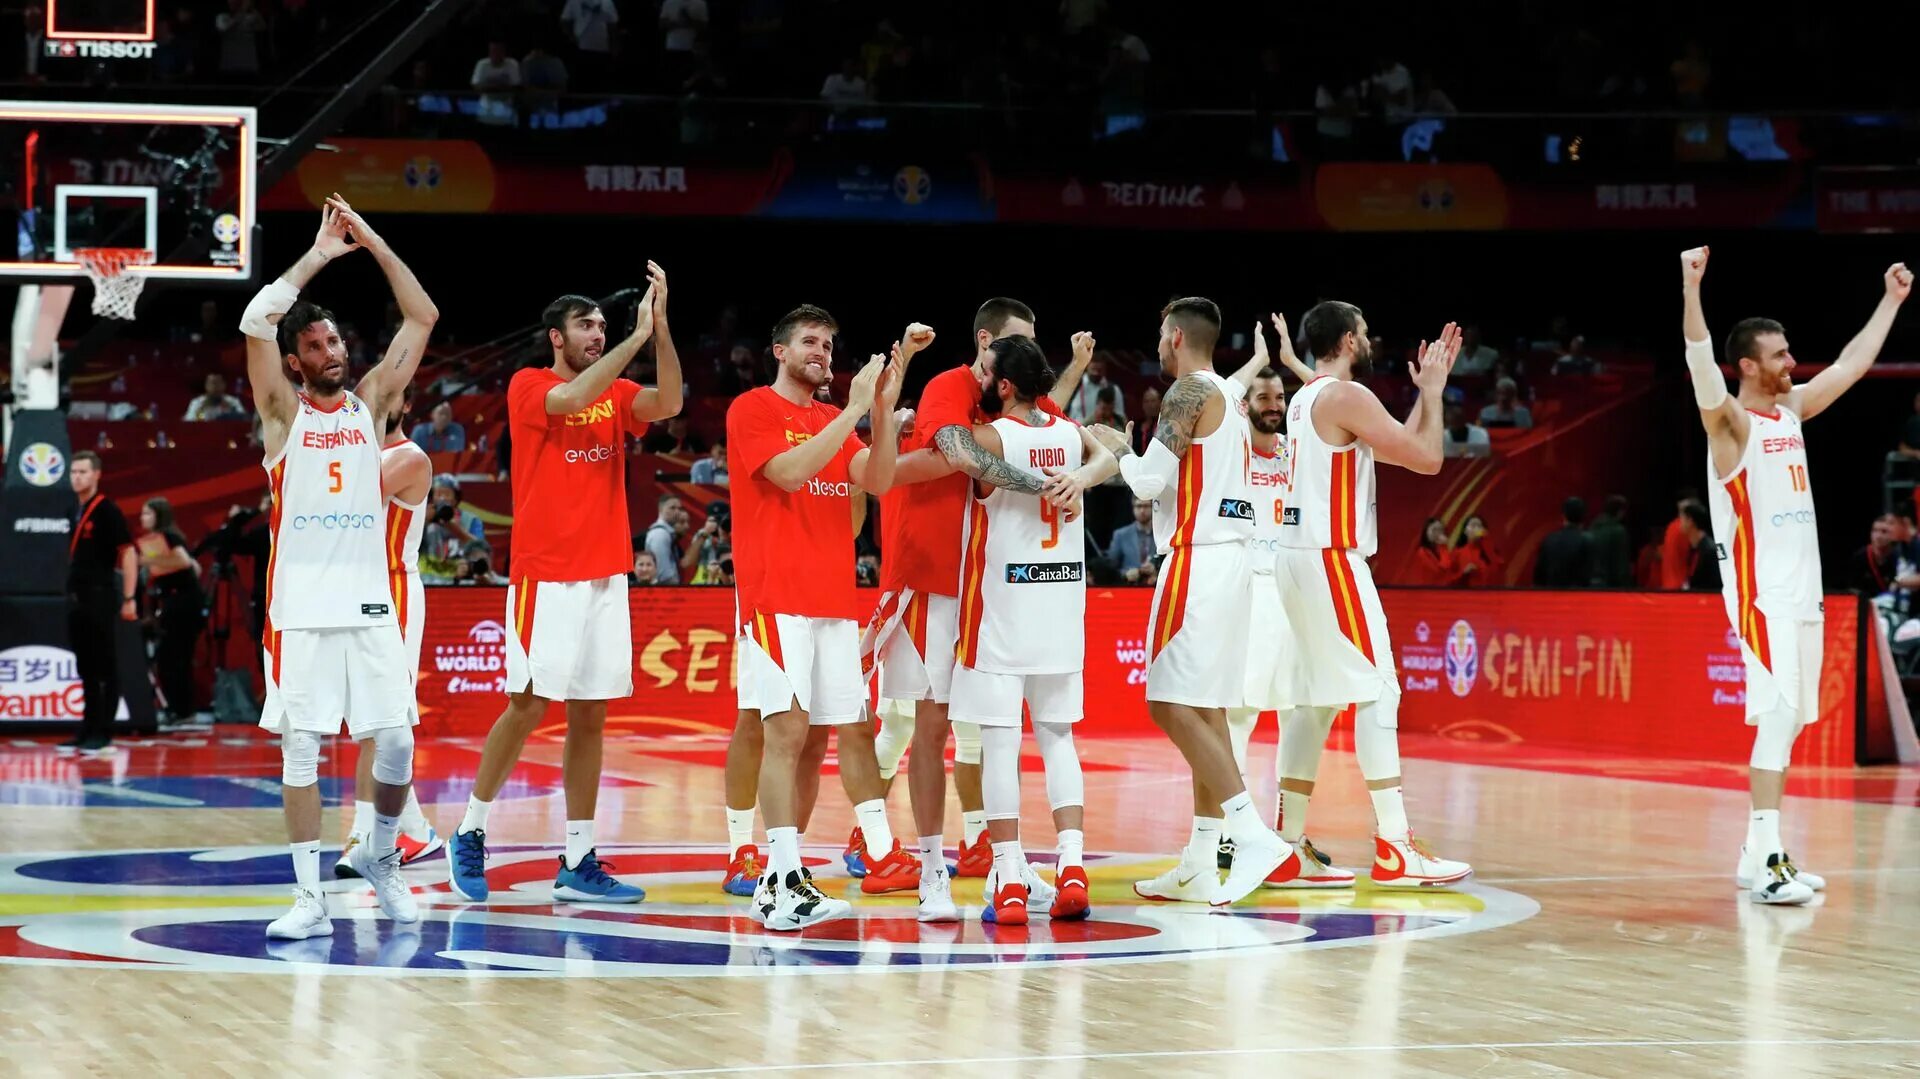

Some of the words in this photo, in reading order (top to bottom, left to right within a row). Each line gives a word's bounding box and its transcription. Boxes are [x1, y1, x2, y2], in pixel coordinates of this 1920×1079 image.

[75, 41, 157, 59] TISSOT
[1029, 448, 1066, 468] RUBIO
[329, 461, 343, 493] 5
[1788, 464, 1806, 492] 10
[1274, 498, 1283, 525] 8
[435, 656, 501, 672] WORLD
[1483, 632, 1633, 703] SEMI-FIN
